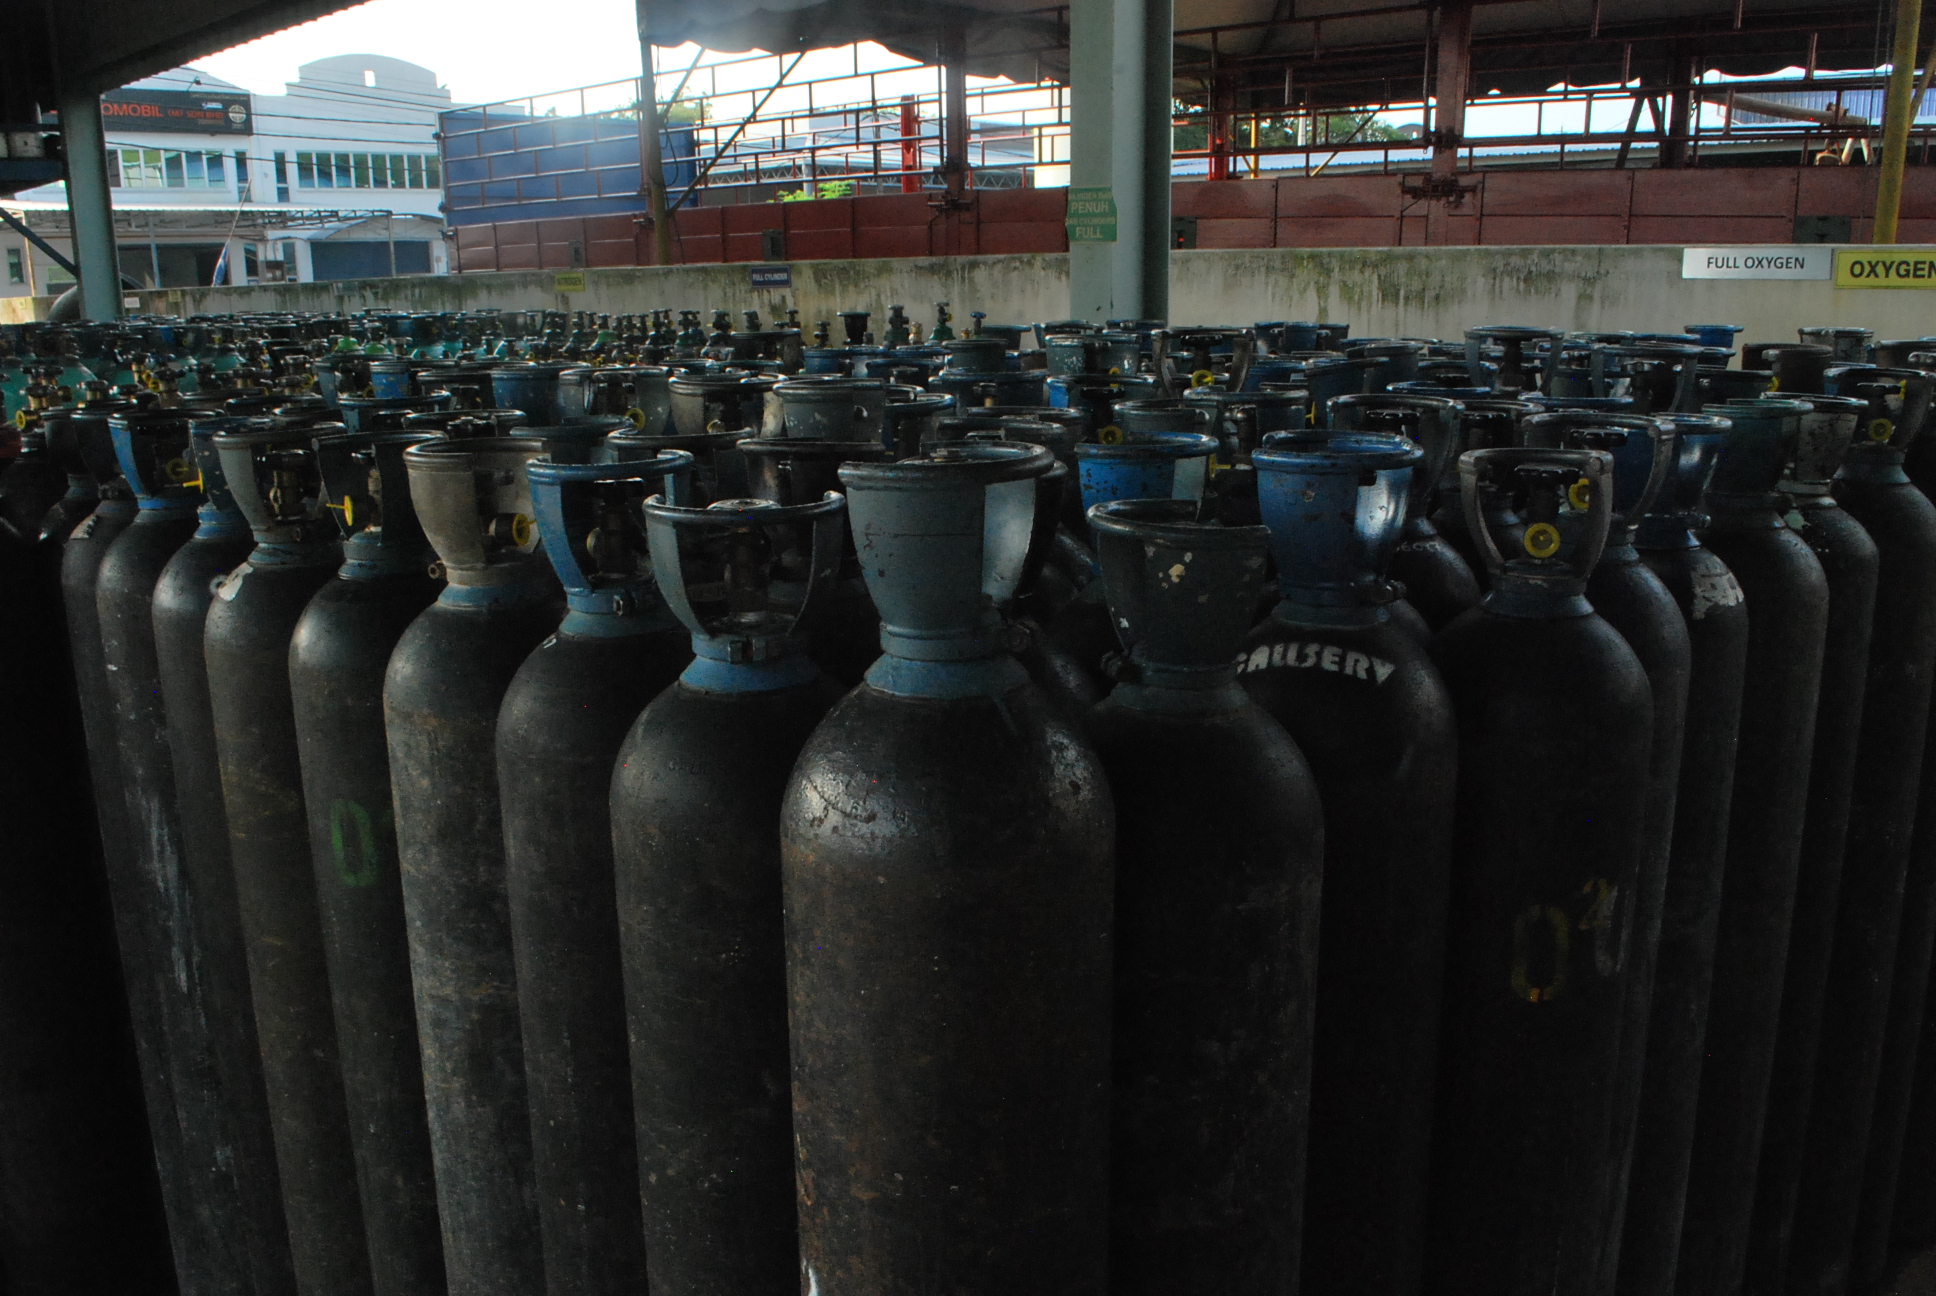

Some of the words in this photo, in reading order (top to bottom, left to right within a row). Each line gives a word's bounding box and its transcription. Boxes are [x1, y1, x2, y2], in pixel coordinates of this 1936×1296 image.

[1071, 201, 1109, 213] PENUH
[1075, 226, 1103, 238] FULL
[1707, 257, 1739, 269] FULL
[1743, 257, 1806, 269] OXYGEN
[1849, 260, 1936, 279] OXYGEN
[752, 273, 764, 281] FULL
[764, 272, 788, 281] CYLINDER
